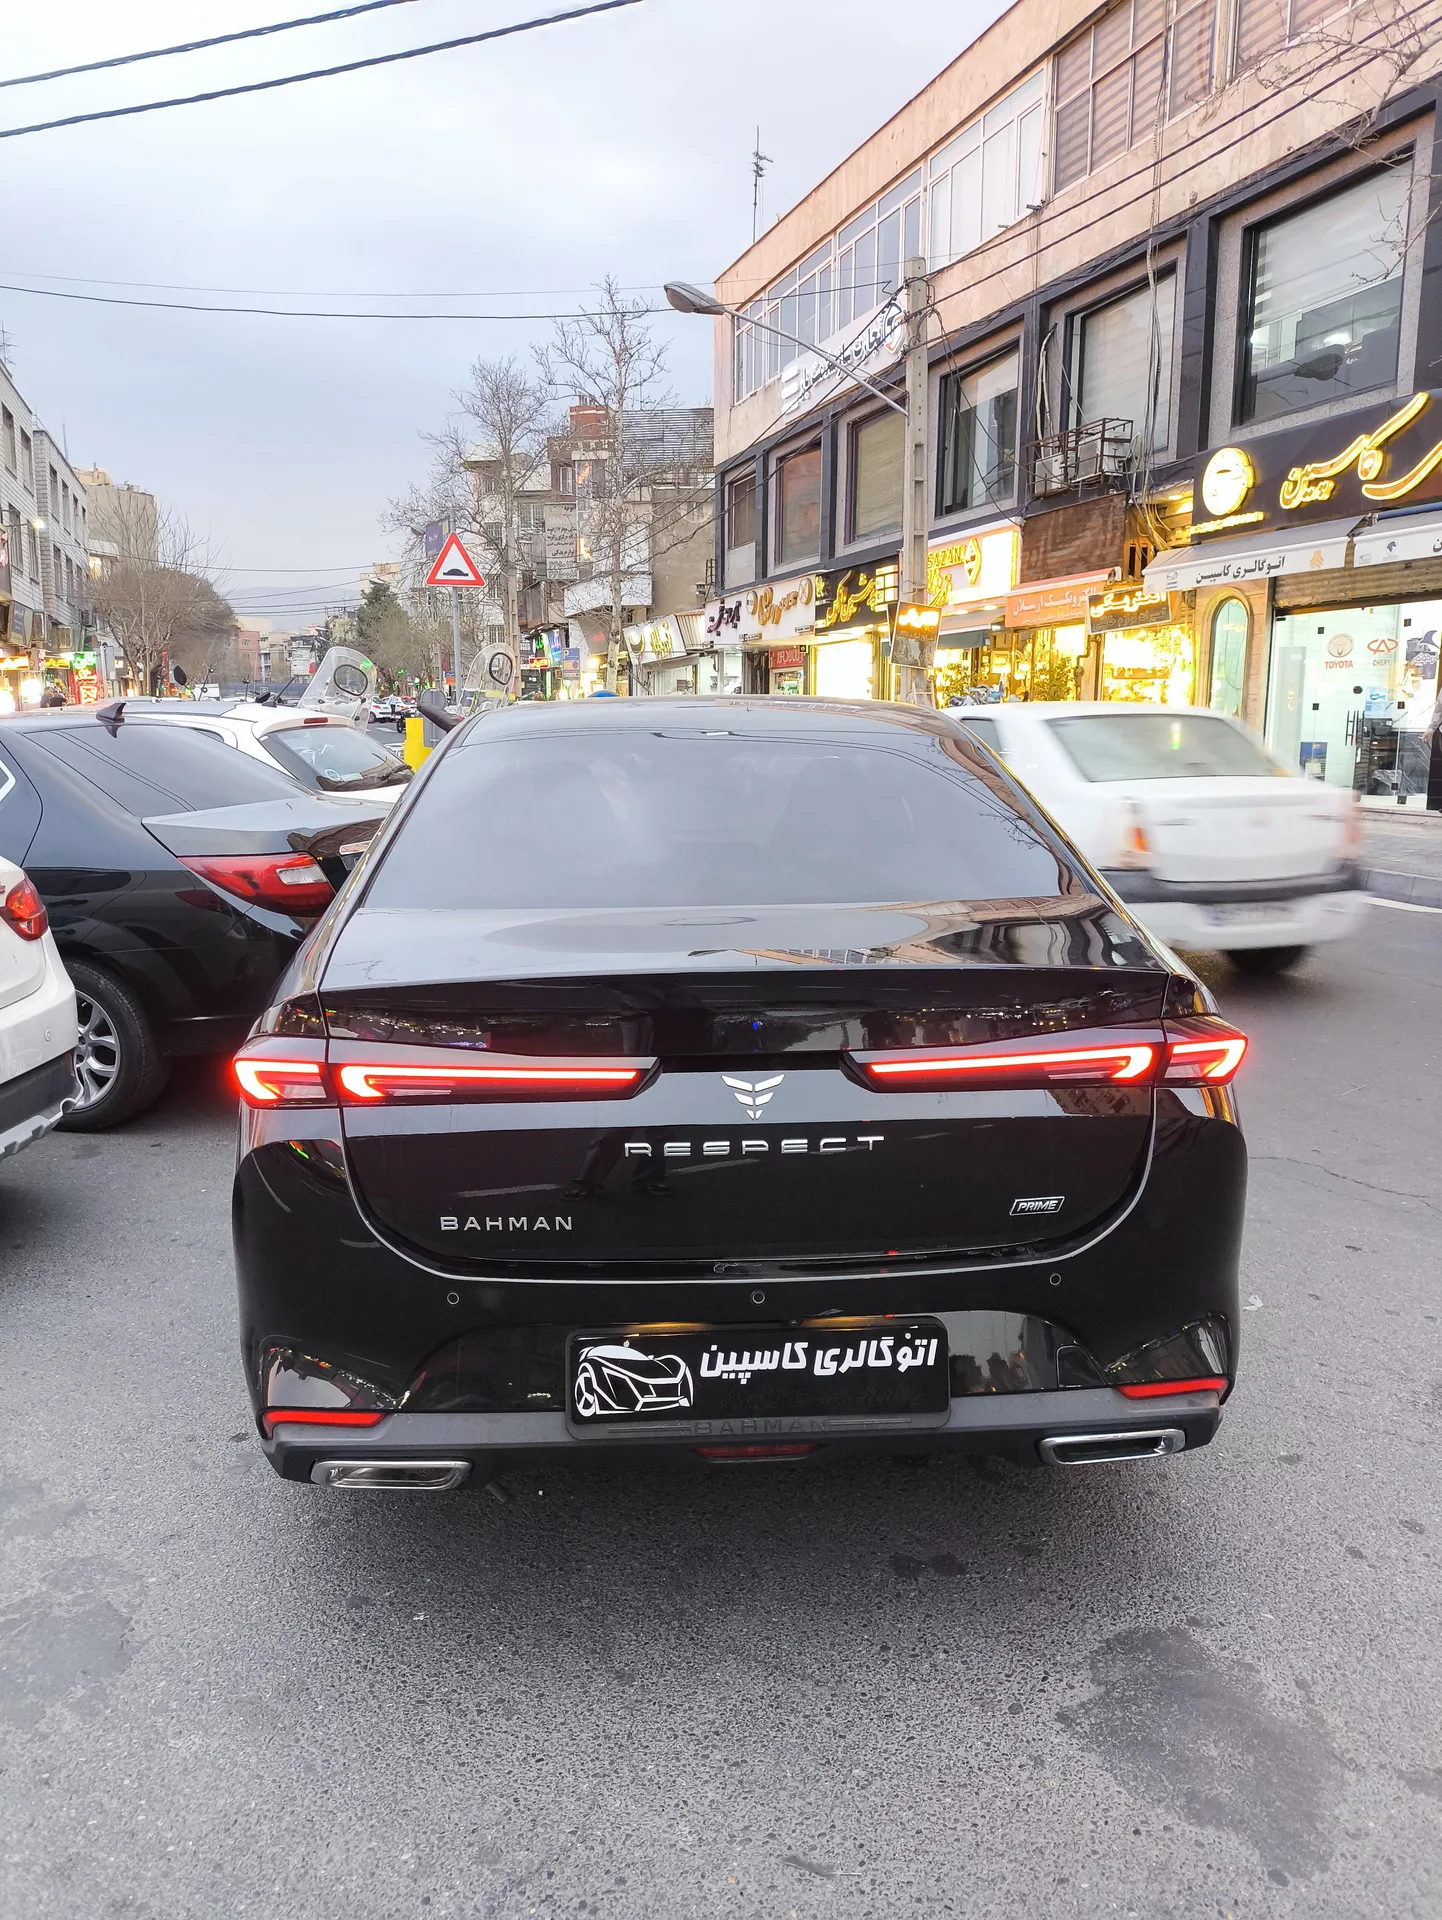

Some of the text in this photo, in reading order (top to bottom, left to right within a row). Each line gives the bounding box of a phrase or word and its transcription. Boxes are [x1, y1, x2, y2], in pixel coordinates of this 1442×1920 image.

[1195, 563, 1231, 585] کاسپین
[1324, 659, 1353, 670] TOYOTA
[1372, 658, 1391, 667] CHERY
[624, 1135, 885, 1157] RESPECT
[1017, 1198, 1060, 1213] PRIME
[440, 1215, 573, 1231] BAHMAN
[699, 1341, 809, 1385] کاسپین
[691, 1417, 828, 1437] BAHMAN
